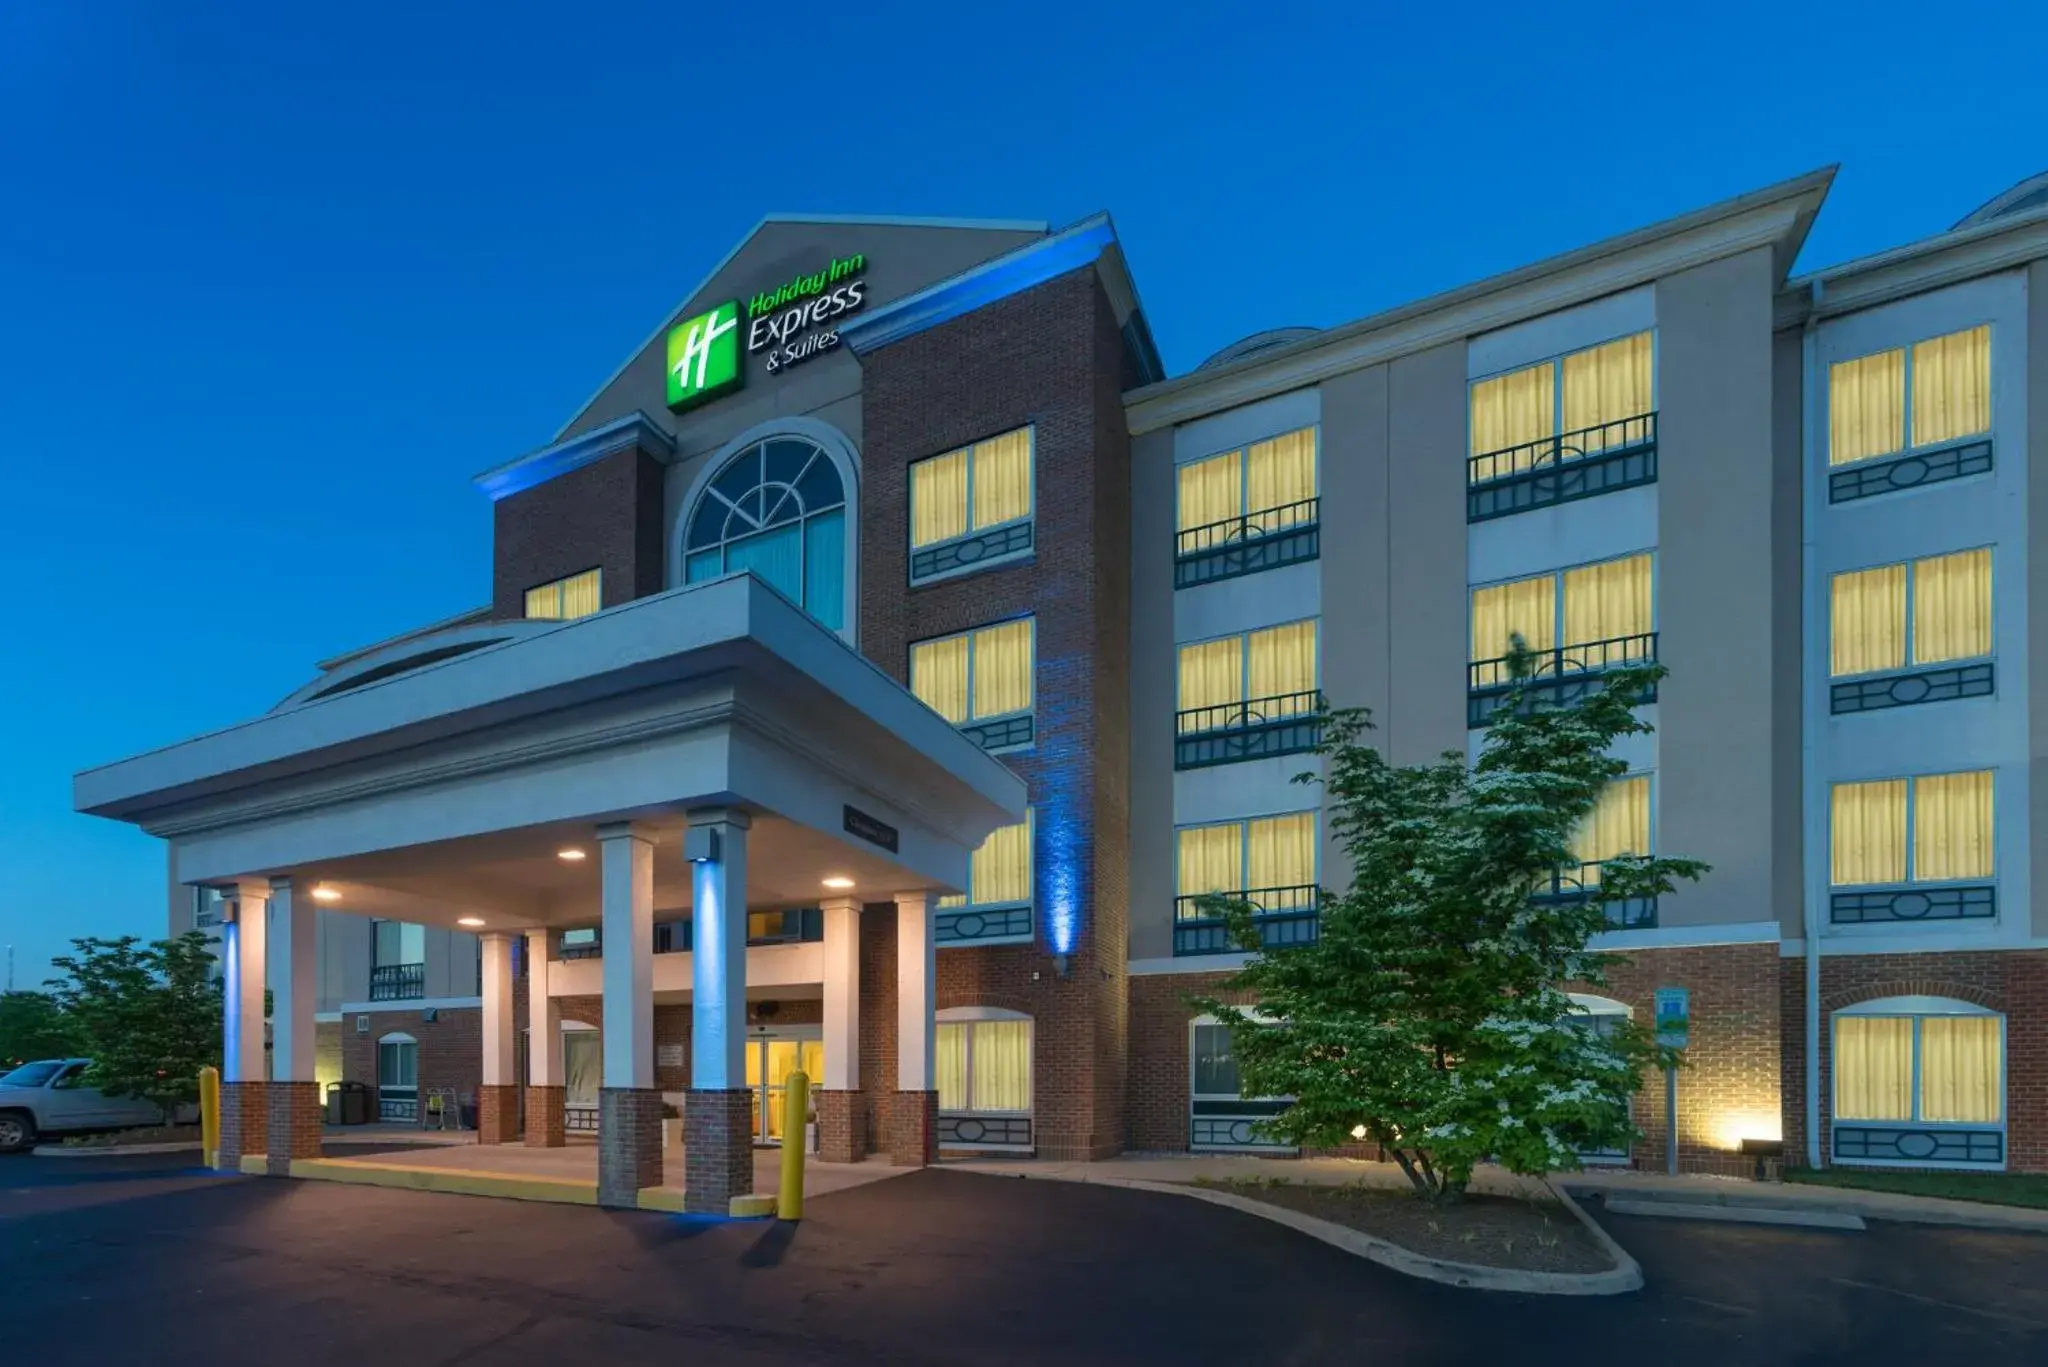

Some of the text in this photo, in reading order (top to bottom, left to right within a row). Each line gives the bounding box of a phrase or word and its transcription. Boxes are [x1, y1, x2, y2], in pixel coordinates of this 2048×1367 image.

[748, 254, 863, 318] Holiday Inn
[748, 281, 863, 350] Express
[766, 330, 839, 371] & Suites
